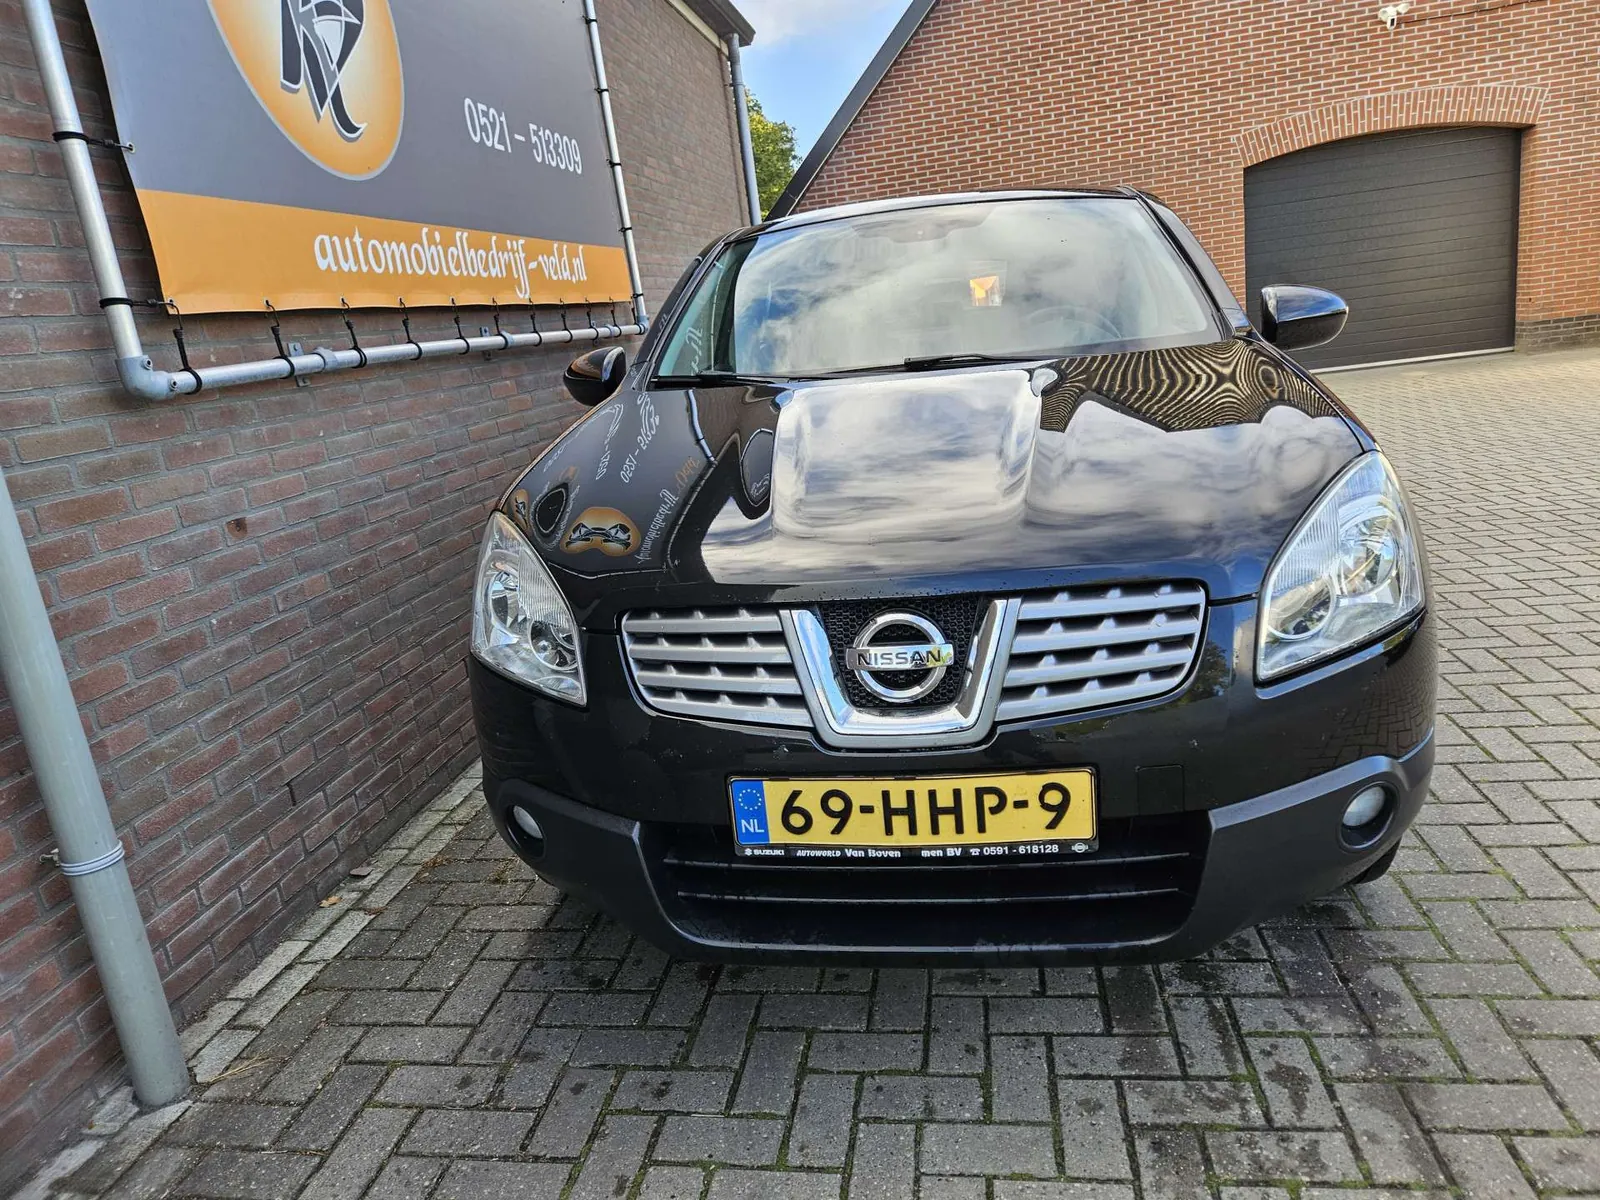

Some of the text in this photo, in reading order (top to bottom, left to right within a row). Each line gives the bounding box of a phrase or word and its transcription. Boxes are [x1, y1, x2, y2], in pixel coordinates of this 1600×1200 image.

[463, 97, 512, 153] 0521
[528, 122, 583, 174] 513309
[313, 225, 588, 300] automobielbedrijf-veld.nl
[857, 649, 942, 666] NISSAN
[741, 819, 765, 834] NL
[781, 782, 1071, 836] 69-HHP-9
[753, 848, 785, 856] SUZUKI
[796, 849, 842, 858] AUTOWORLD
[845, 848, 865, 858] Van
[946, 847, 962, 857] BV
[983, 846, 1010, 856] 0591
[1018, 844, 1059, 854] 618128
